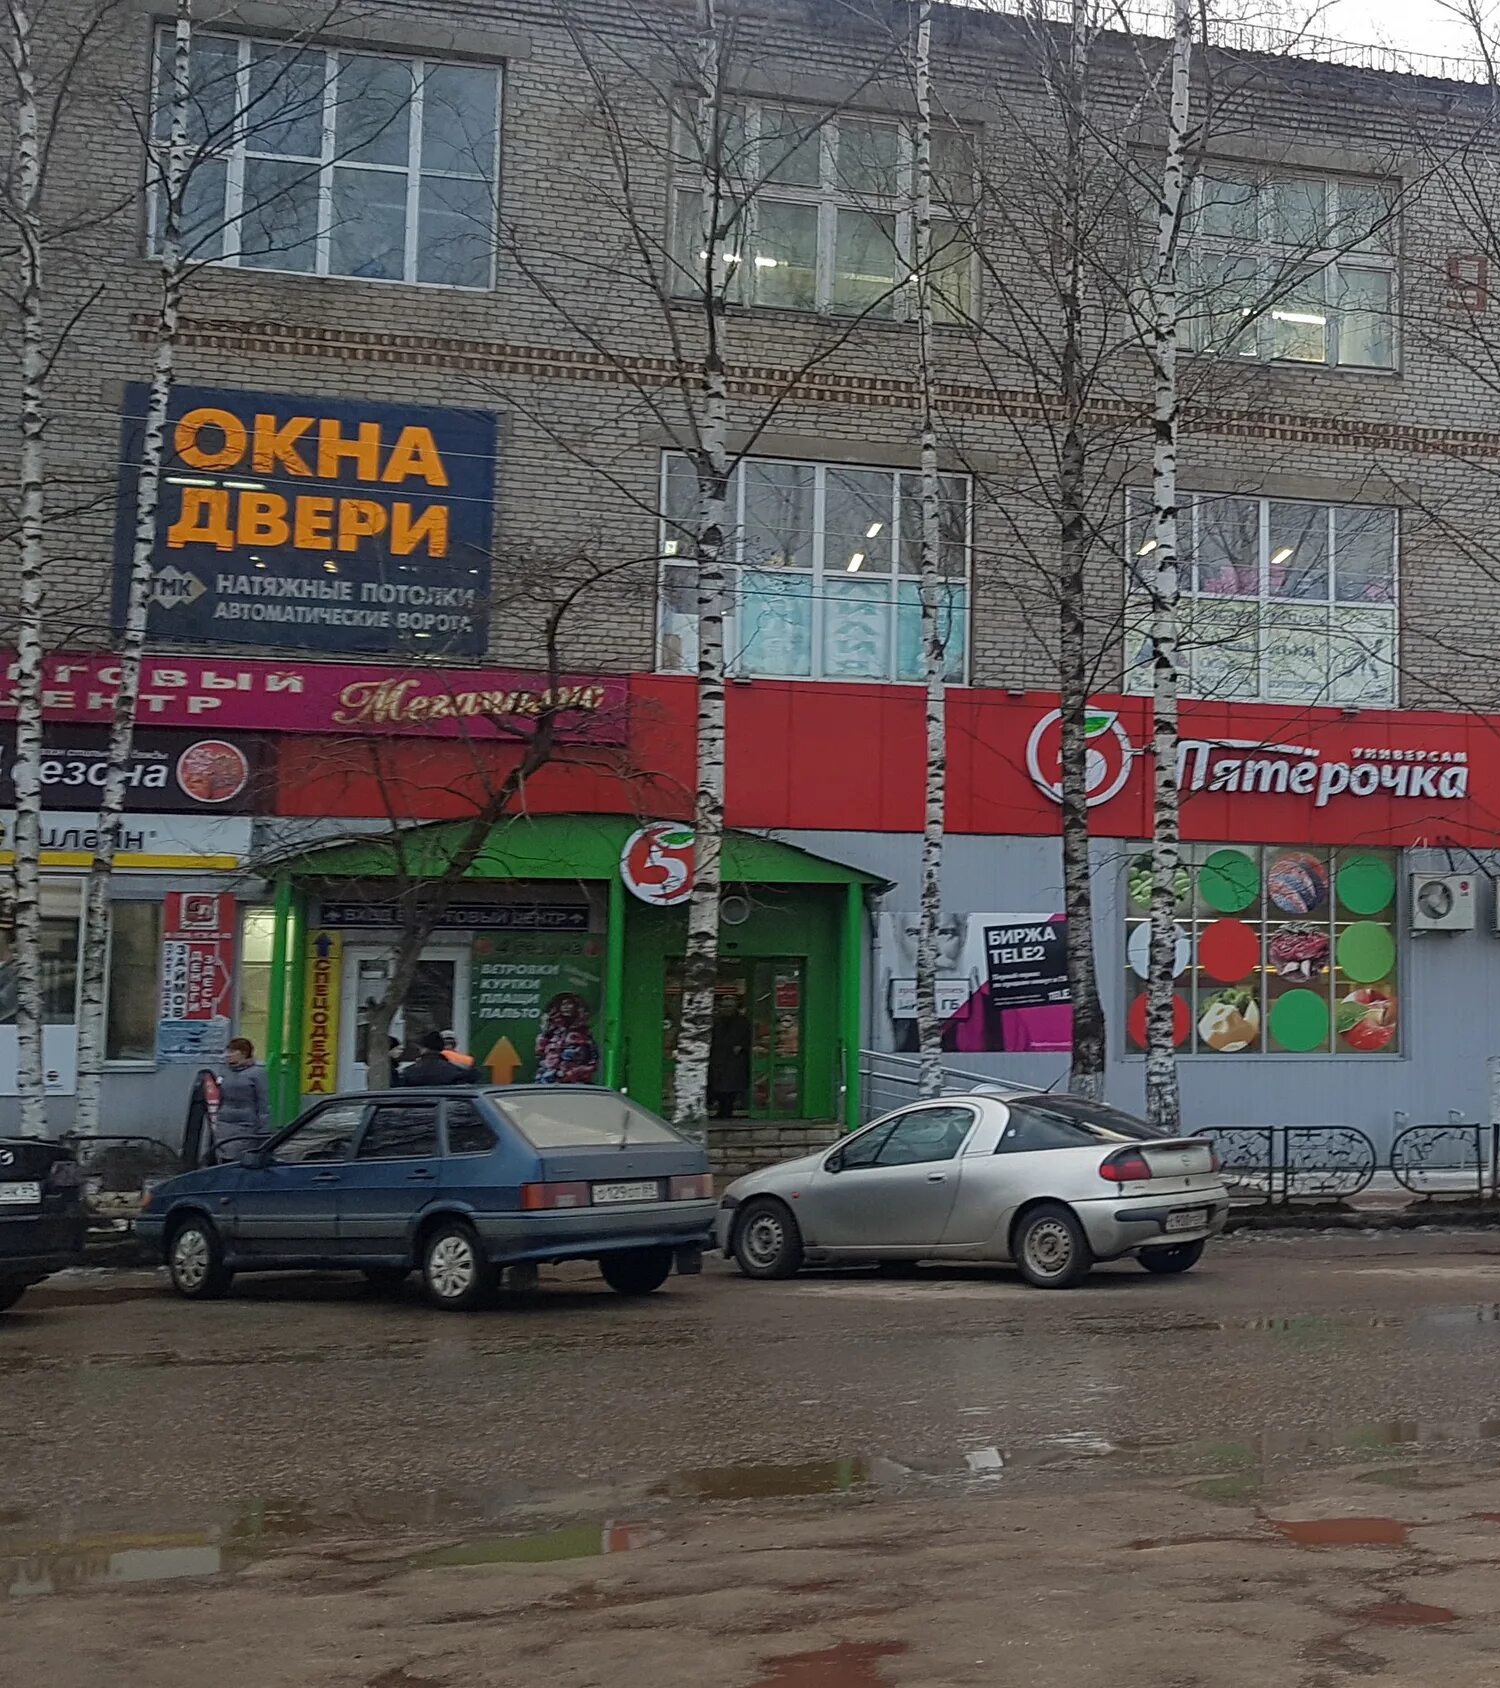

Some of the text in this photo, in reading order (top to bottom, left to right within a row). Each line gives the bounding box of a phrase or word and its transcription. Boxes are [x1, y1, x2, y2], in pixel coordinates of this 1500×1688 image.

[174, 407, 448, 487] ОКНА
[166, 487, 448, 558] ДВЕРИ
[216, 574, 475, 607] НАТЯЖНЫЕ ПОТОЛКИ
[213, 602, 473, 632] АВТОМАТИЧЕСКИЕ ВОРОТА
[1351, 747, 1468, 764] УНИВЕРСАМ
[988, 926, 1057, 946] БИРЖА
[989, 946, 1046, 964] TELE2
[480, 963, 560, 976] ВЕТРОВКИ
[479, 978, 541, 990] КУРТКИ
[479, 992, 540, 1005] ПЛАЩИ
[478, 1007, 542, 1019] ПАЛЬТО
[305, 959, 331, 1093] СПЕЦОДЕЖДА
